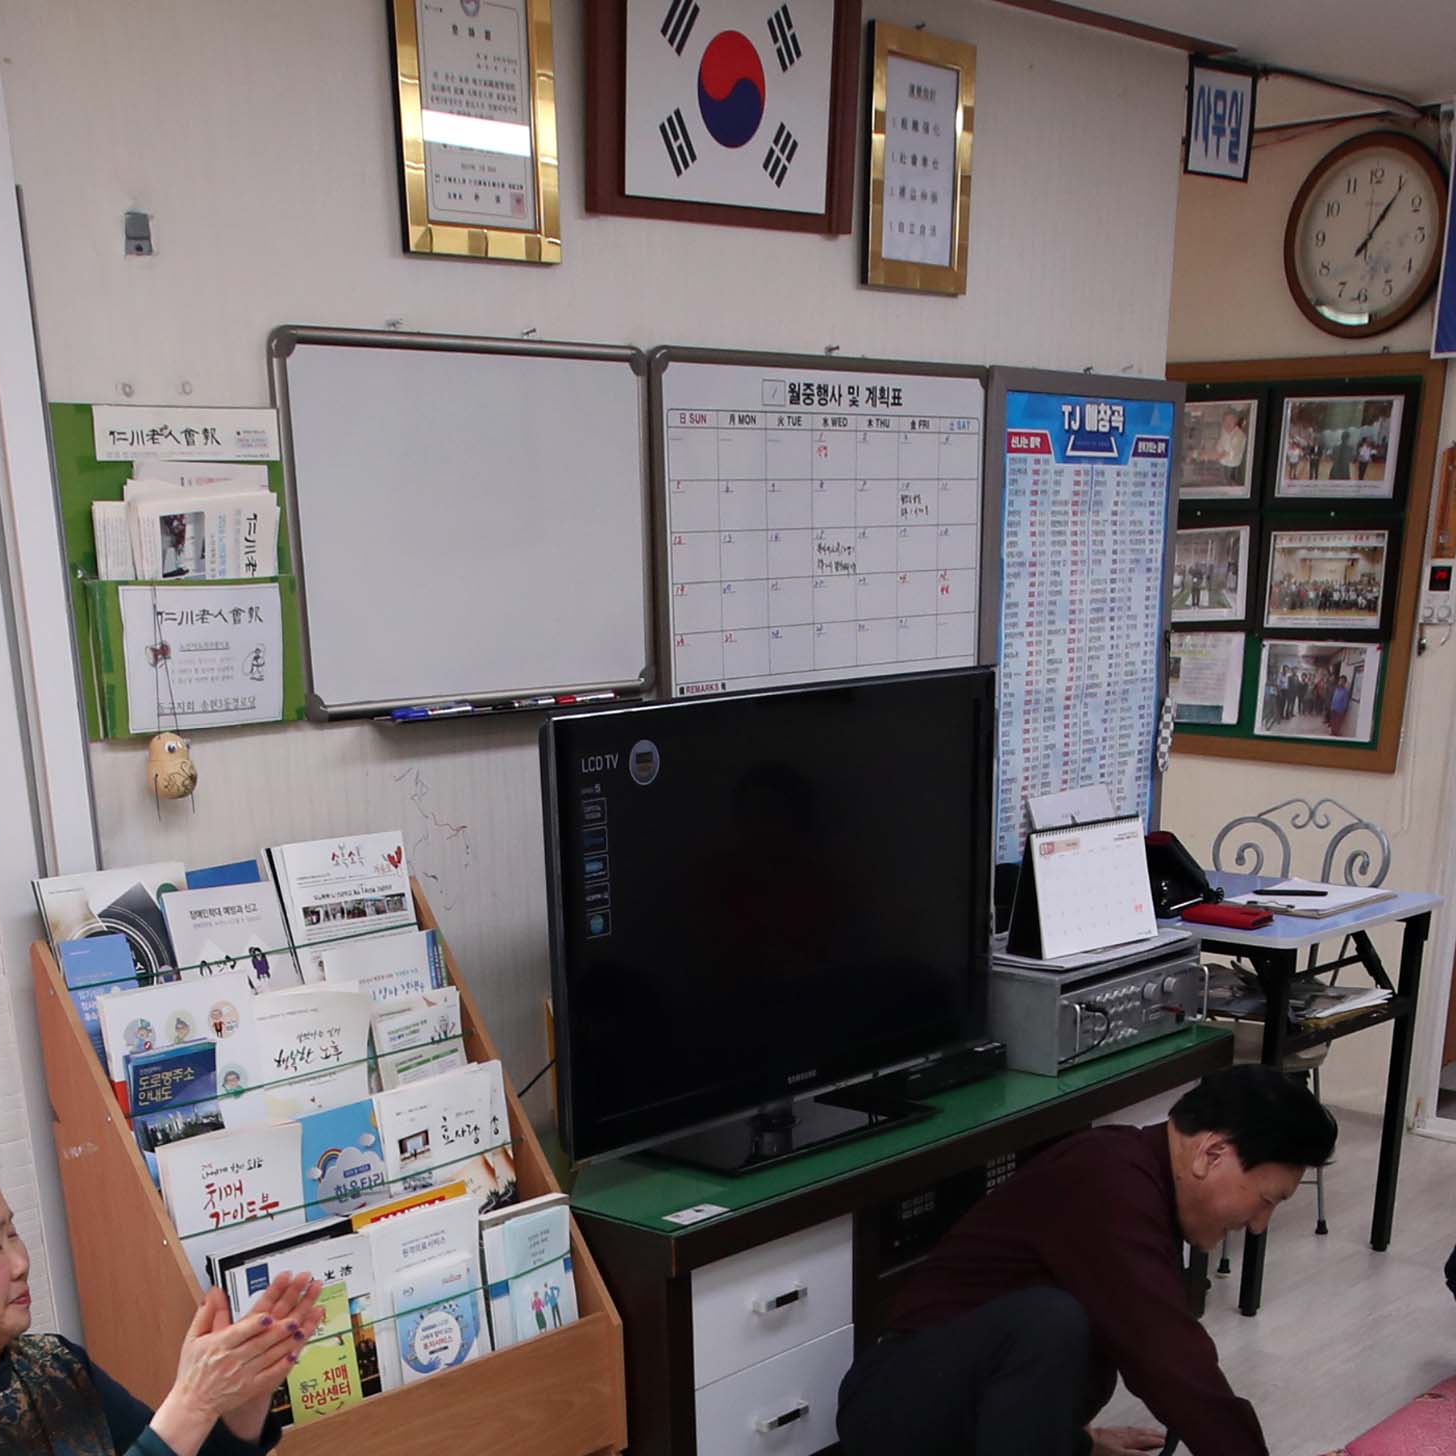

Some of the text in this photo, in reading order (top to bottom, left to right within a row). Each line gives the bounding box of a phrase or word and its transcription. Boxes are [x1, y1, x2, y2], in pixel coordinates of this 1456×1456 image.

[1194, 85, 1245, 164] 사무실
[1369, 167, 1385, 184] 12
[1345, 177, 1359, 194] 11
[1325, 200, 1341, 218] 10
[1410, 194, 1423, 213] 2
[1315, 230, 1326, 248] 9
[1414, 226, 1426, 244] 3
[1318, 261, 1331, 276] 8
[1337, 281, 1348, 299] 7
[1381, 279, 1394, 297] 5
[788, 382, 904, 408] 월중행사 및 계획표
[689, 414, 707, 425] SUN
[738, 415, 757, 425] MON
[786, 415, 803, 427] TUE
[831, 417, 849, 428] WED
[875, 418, 891, 428] THU
[918, 419, 931, 430] FRI
[1061, 404, 1081, 431] TJ
[685, 683, 720, 695] REMARKS
[581, 753, 620, 773] LCD TV
[274, 1046, 314, 1072] 행복한
[138, 1066, 196, 1092] 도로명주소
[138, 1086, 174, 1107] 안내도
[203, 1179, 244, 1210] 치매
[323, 1364, 349, 1384] 치매
[301, 1381, 352, 1410] 안심센터
